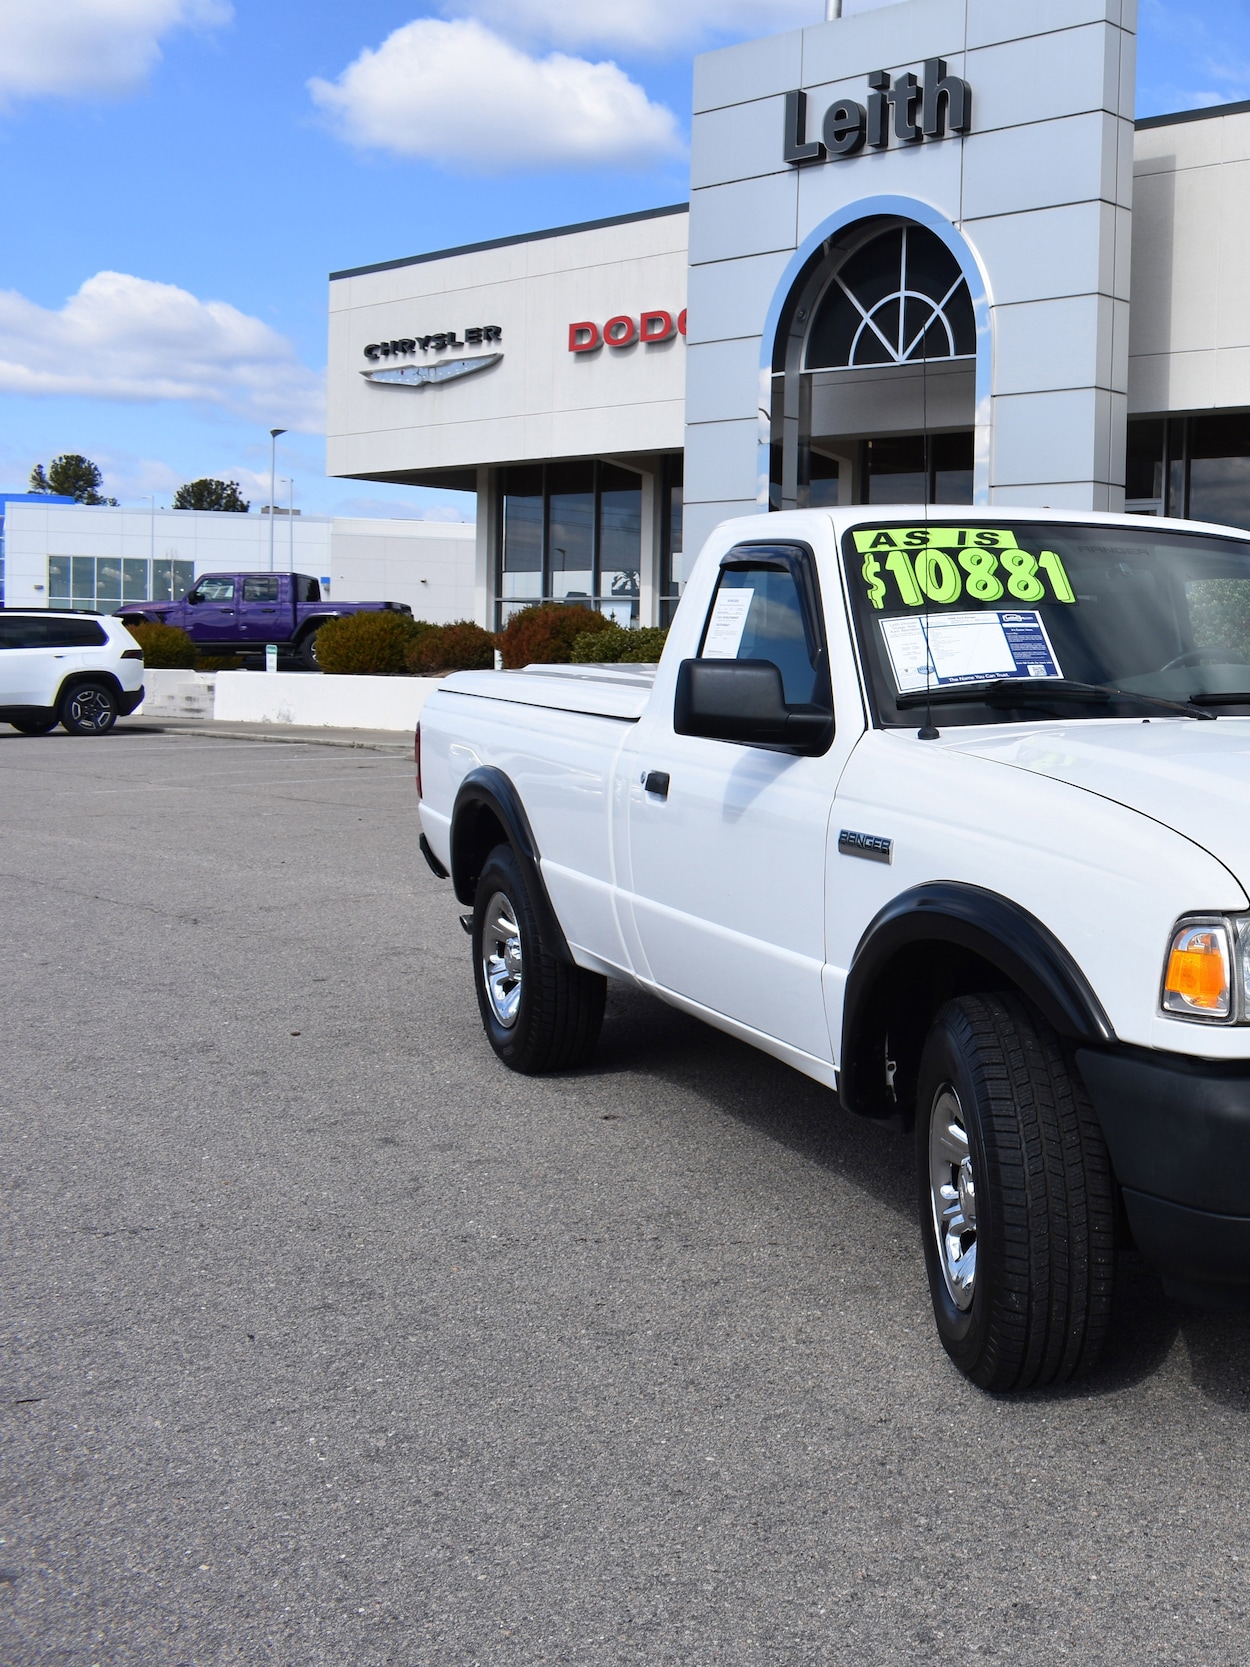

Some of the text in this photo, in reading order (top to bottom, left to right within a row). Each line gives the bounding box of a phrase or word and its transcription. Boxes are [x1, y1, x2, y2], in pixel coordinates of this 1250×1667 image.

[783, 57, 972, 164] Leith
[363, 325, 502, 359] CHRYSLER
[869, 530, 1000, 549] AS IS
[861, 547, 1076, 610] $10881
[840, 830, 891, 855] RANGER
